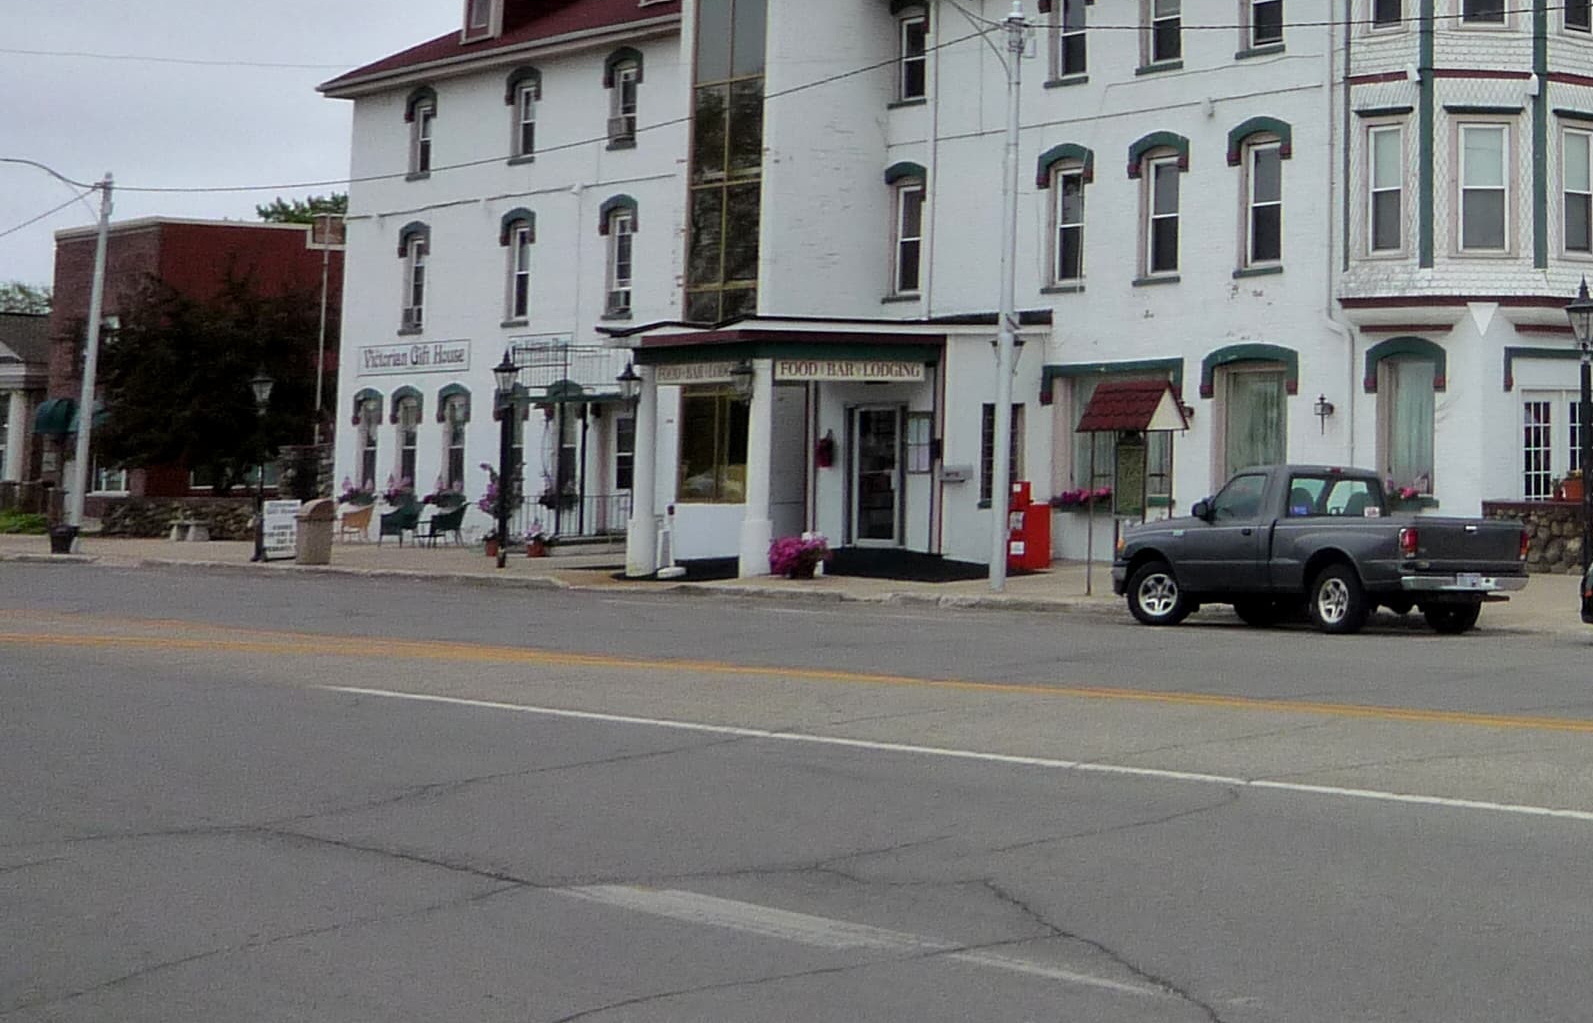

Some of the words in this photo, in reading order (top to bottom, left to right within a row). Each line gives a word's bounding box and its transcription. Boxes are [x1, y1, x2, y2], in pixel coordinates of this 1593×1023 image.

[364, 348, 407, 369] Victorian
[410, 344, 430, 366] Gift
[433, 344, 465, 365] House
[780, 361, 818, 376] FOOD
[826, 361, 854, 377] BAR
[862, 362, 921, 378] LODGING
